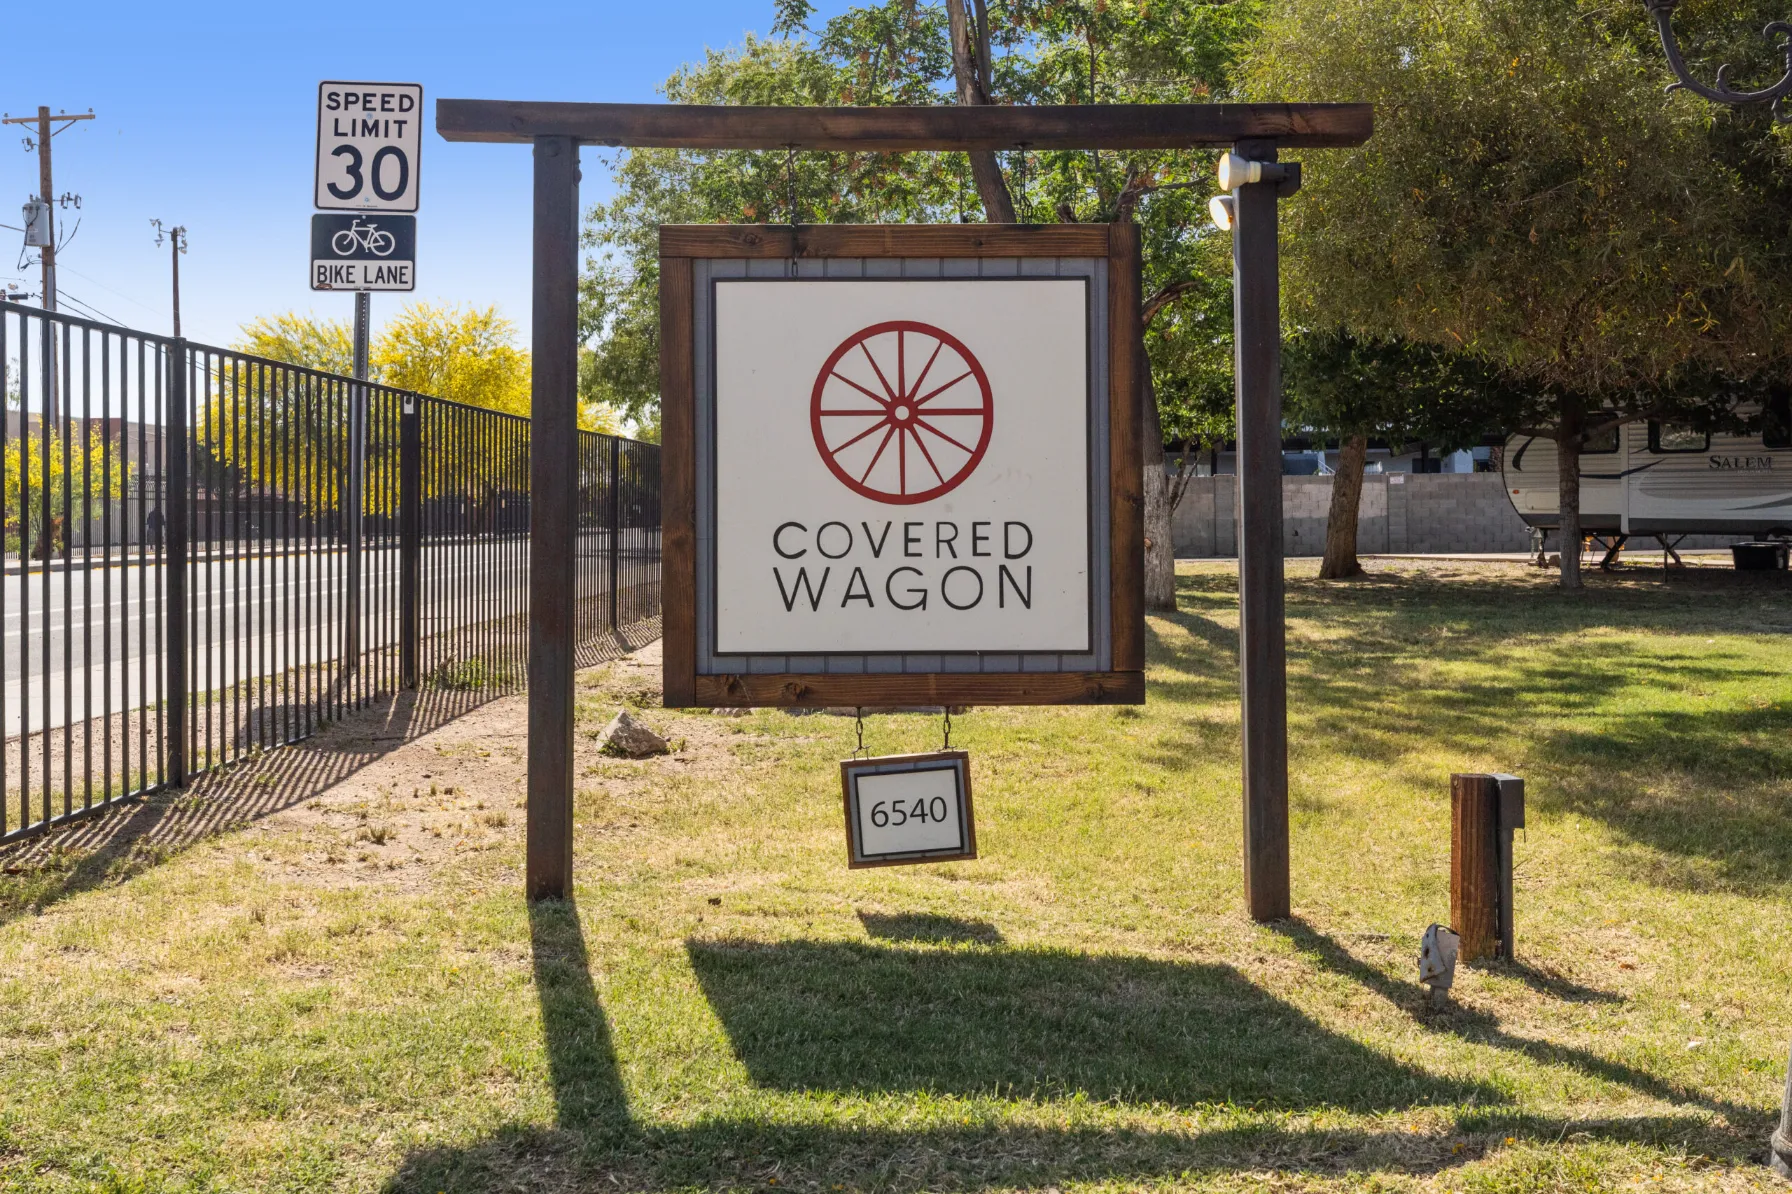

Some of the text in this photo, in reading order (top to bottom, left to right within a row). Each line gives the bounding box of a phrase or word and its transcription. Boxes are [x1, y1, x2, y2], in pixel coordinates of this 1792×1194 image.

[326, 92, 414, 112] SPEED
[334, 118, 408, 138] LIMIT
[327, 144, 409, 201] 30
[317, 265, 409, 284] BIKE LANE
[1709, 455, 1772, 469] SALEM
[773, 521, 1033, 559] COVERED
[773, 564, 1032, 612] WAGON
[871, 796, 947, 828] 6540
